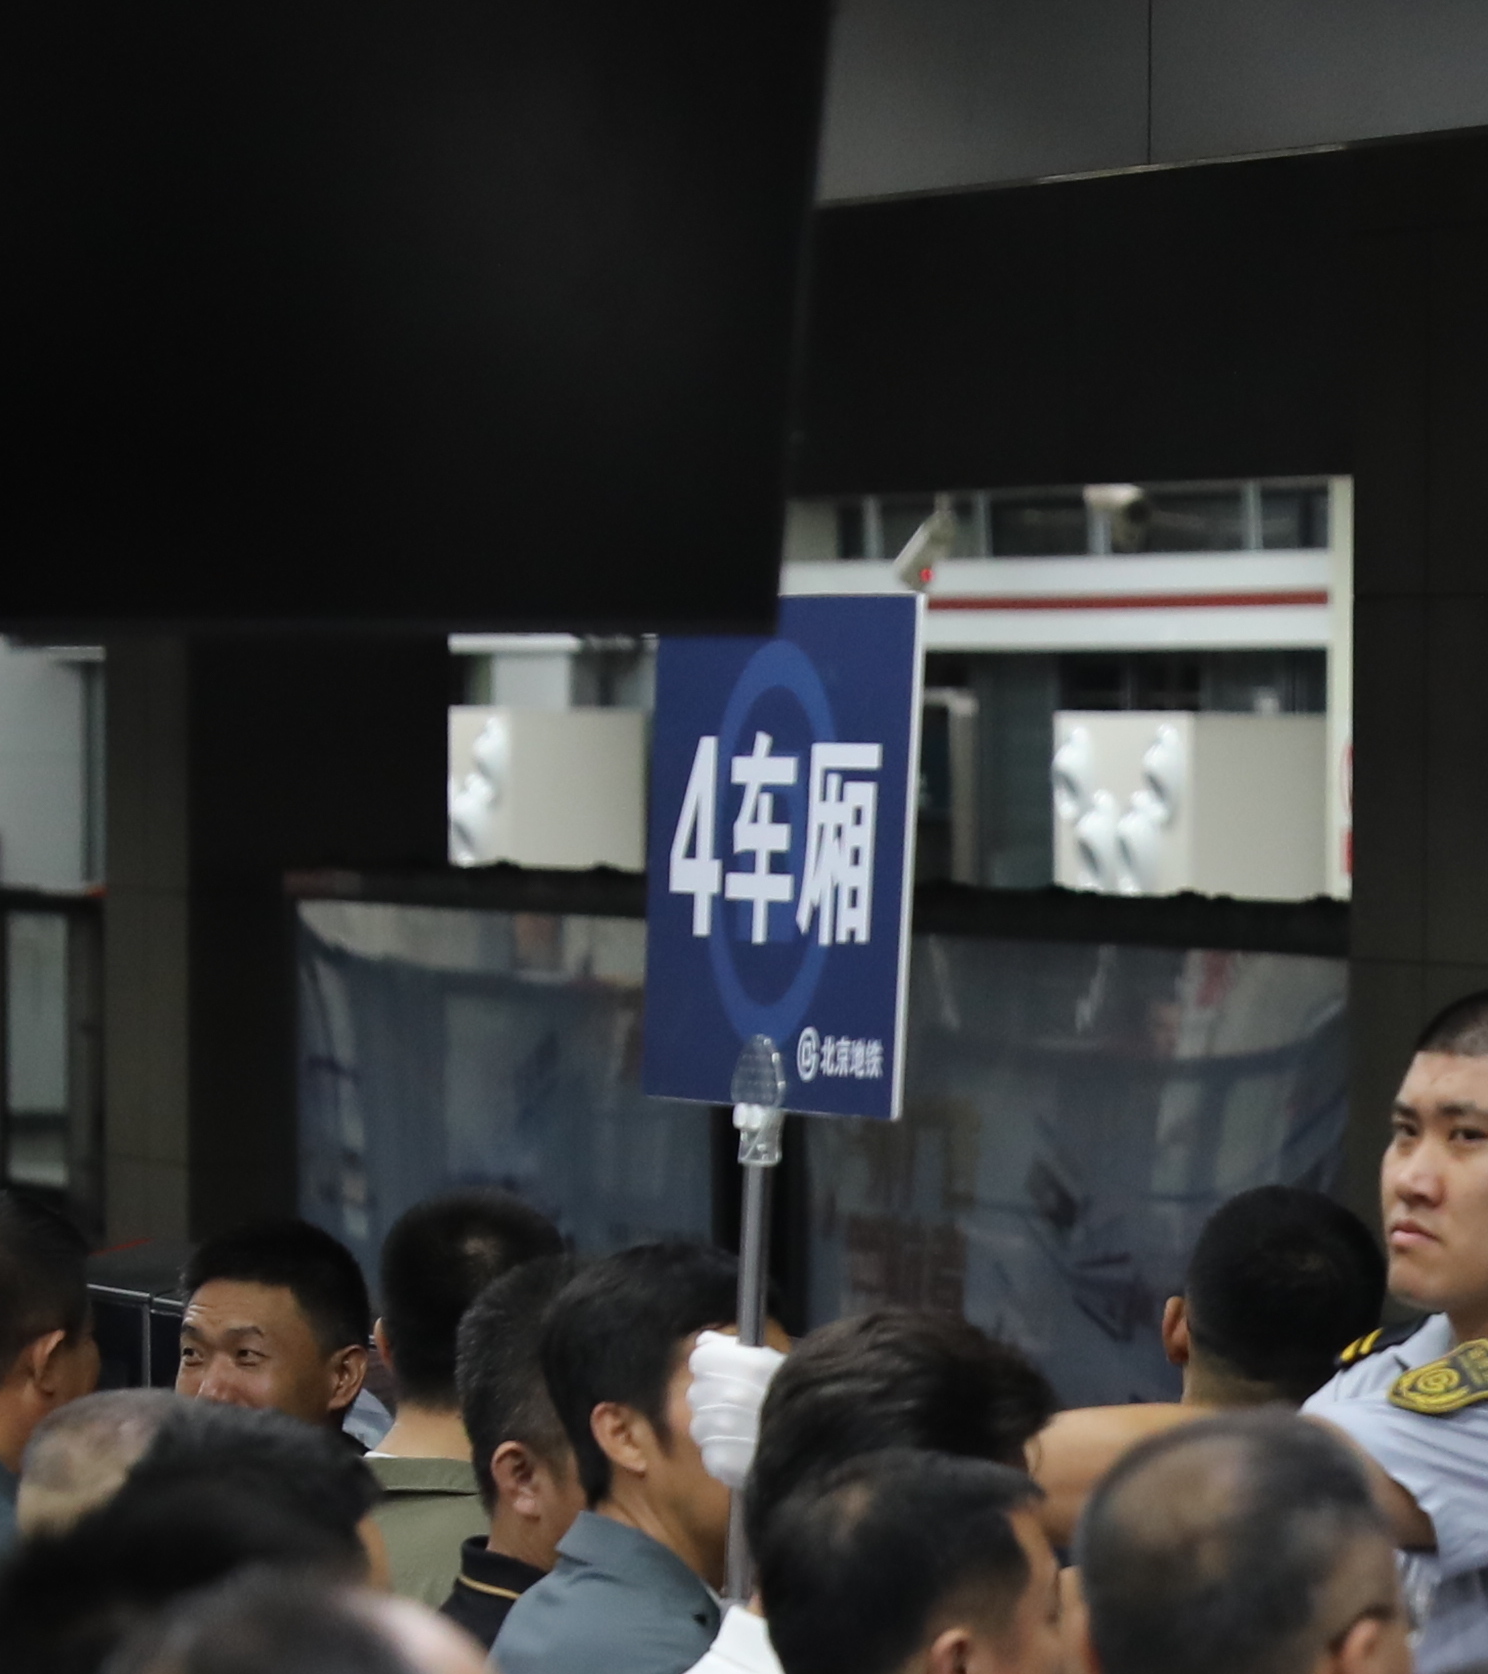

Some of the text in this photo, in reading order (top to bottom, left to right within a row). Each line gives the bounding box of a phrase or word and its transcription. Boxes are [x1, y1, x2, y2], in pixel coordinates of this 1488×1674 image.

[668, 730, 883, 946] 4车厢
[820, 1035, 884, 1079] 北京地铁
